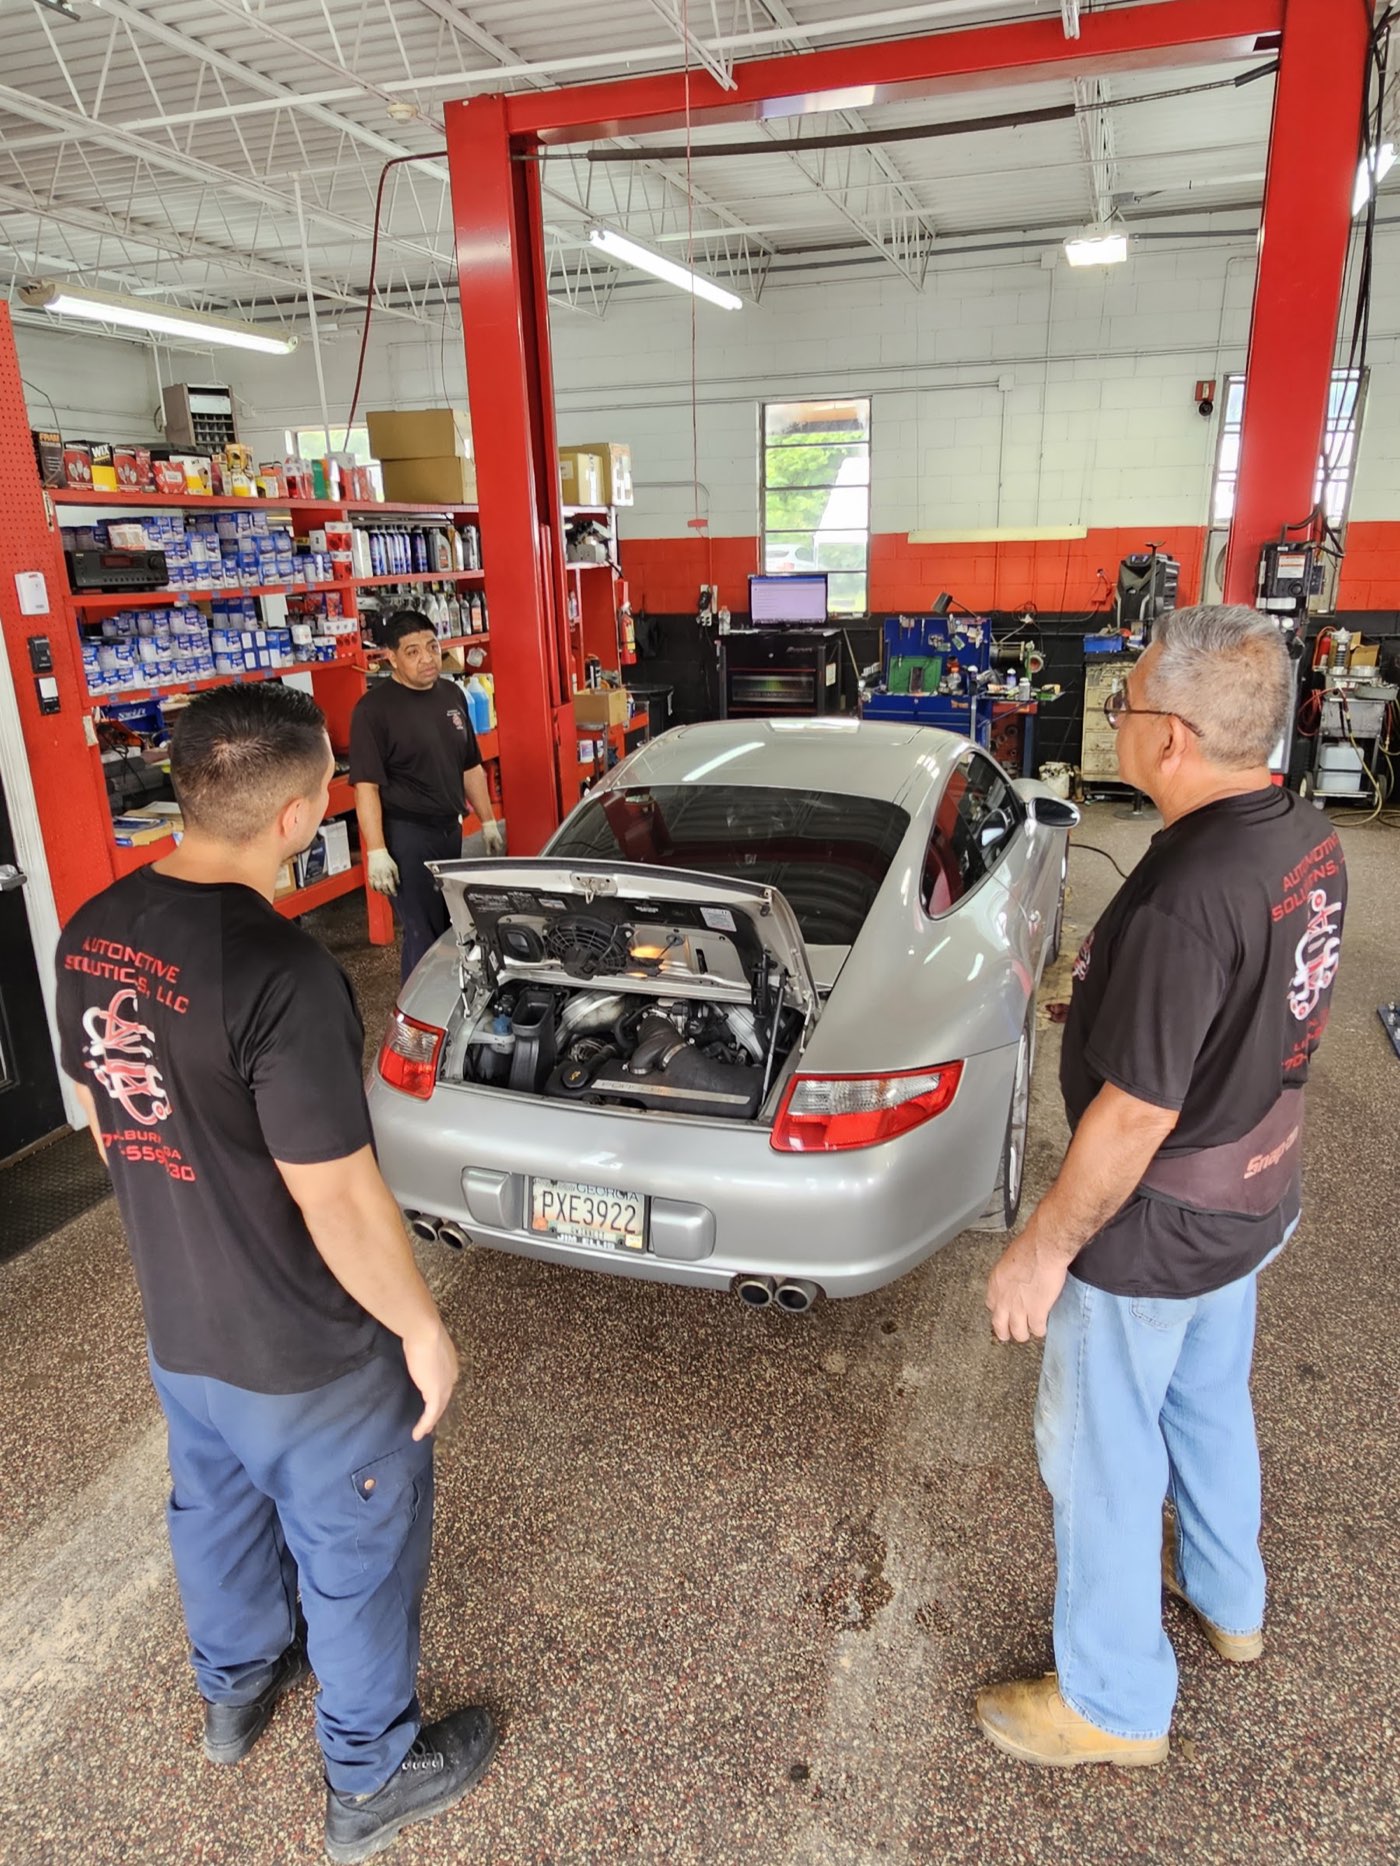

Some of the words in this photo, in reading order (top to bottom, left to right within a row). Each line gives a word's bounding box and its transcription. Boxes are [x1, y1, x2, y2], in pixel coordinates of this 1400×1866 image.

[92, 444, 110, 458] WIX
[1282, 831, 1339, 893] AUTOMOTIV
[64, 954, 151, 1000] SOLUTIOS,
[156, 986, 190, 1015] LLC
[542, 1190, 636, 1235] PXE3922
